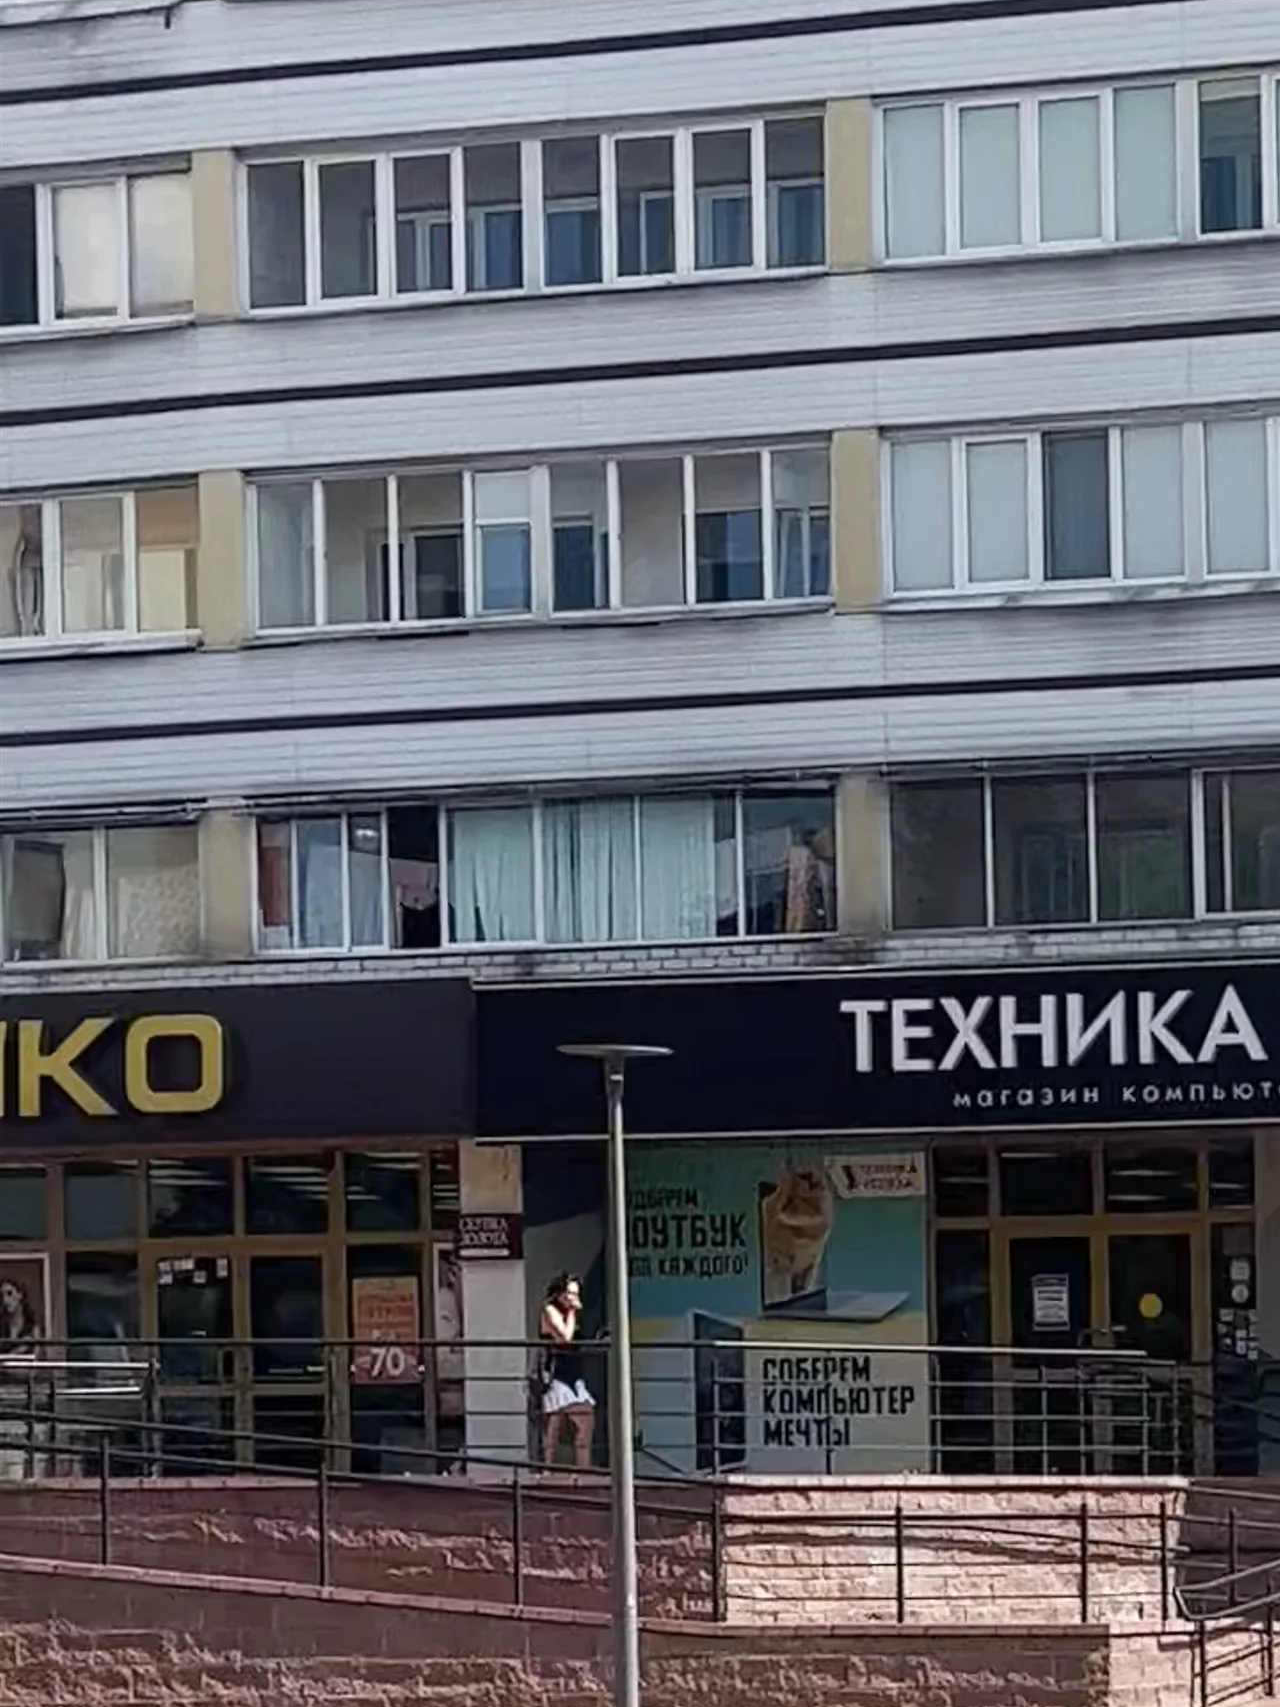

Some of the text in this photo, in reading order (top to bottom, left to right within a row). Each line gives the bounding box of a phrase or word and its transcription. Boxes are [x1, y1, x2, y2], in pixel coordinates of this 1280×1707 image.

[840, 985, 1267, 1073] ТЕХНИКА
[954, 1087, 1099, 1108] магазин
[627, 1213, 747, 1249] ОУТБУК
[763, 1385, 915, 1415] КОМПЬЮТЕР
[763, 1418, 850, 1447] МЕЧТЫ
